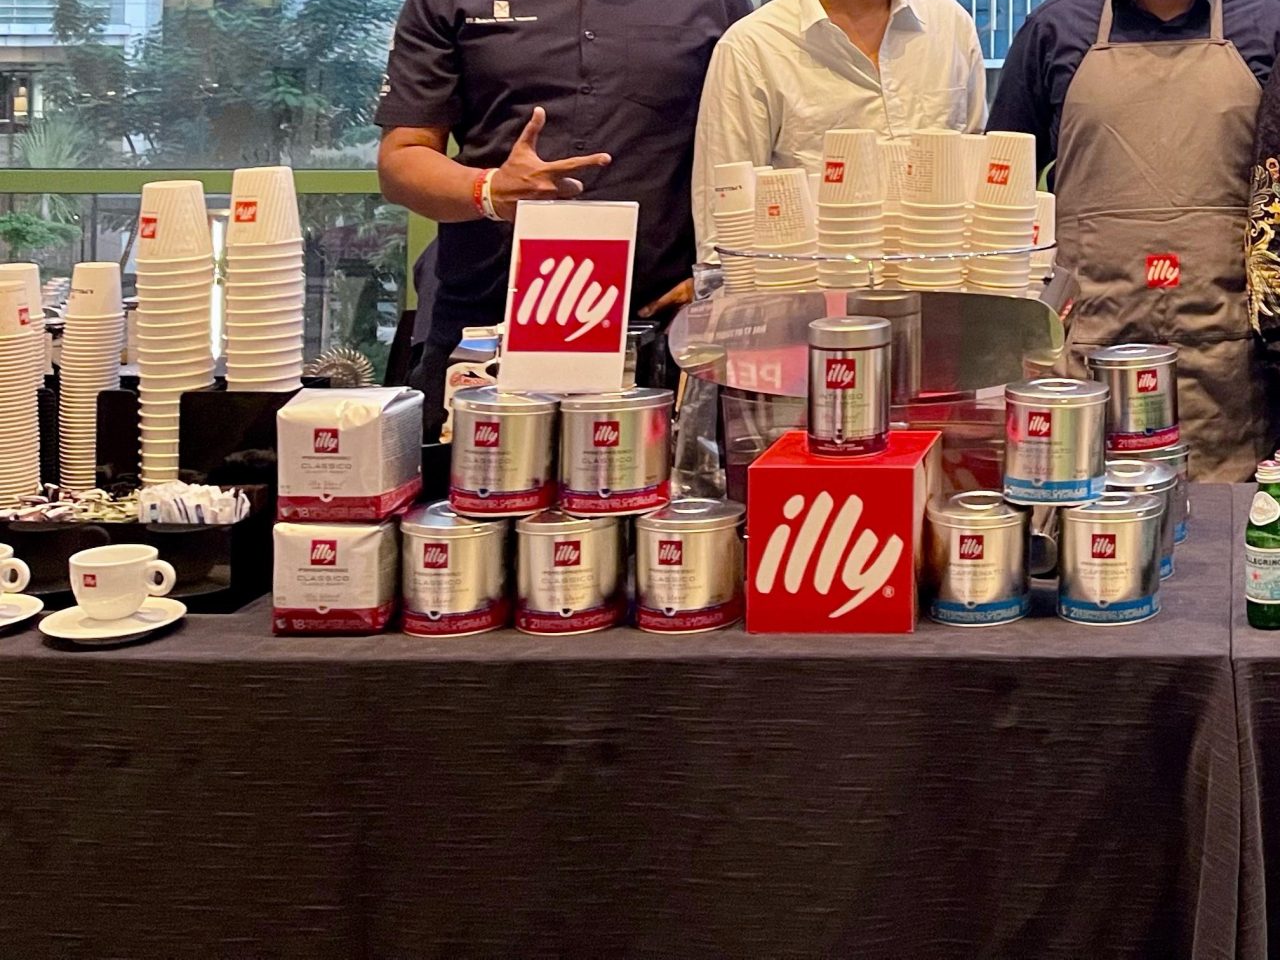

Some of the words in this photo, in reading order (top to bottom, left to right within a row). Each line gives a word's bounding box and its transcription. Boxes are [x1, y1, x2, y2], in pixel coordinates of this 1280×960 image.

[1147, 260, 1179, 286] illy
[516, 256, 619, 341] illy
[827, 363, 855, 386] illy
[1138, 373, 1157, 391] illy
[1029, 415, 1050, 434] illy
[315, 432, 338, 451] illy
[477, 425, 498, 445] illy
[595, 425, 618, 445] illy
[312, 544, 335, 563] illy
[425, 546, 446, 565] illy
[555, 545, 579, 563] illy
[659, 545, 681, 564] illy
[755, 491, 904, 618] illy
[961, 538, 982, 558] illy
[1093, 537, 1115, 556] illy
